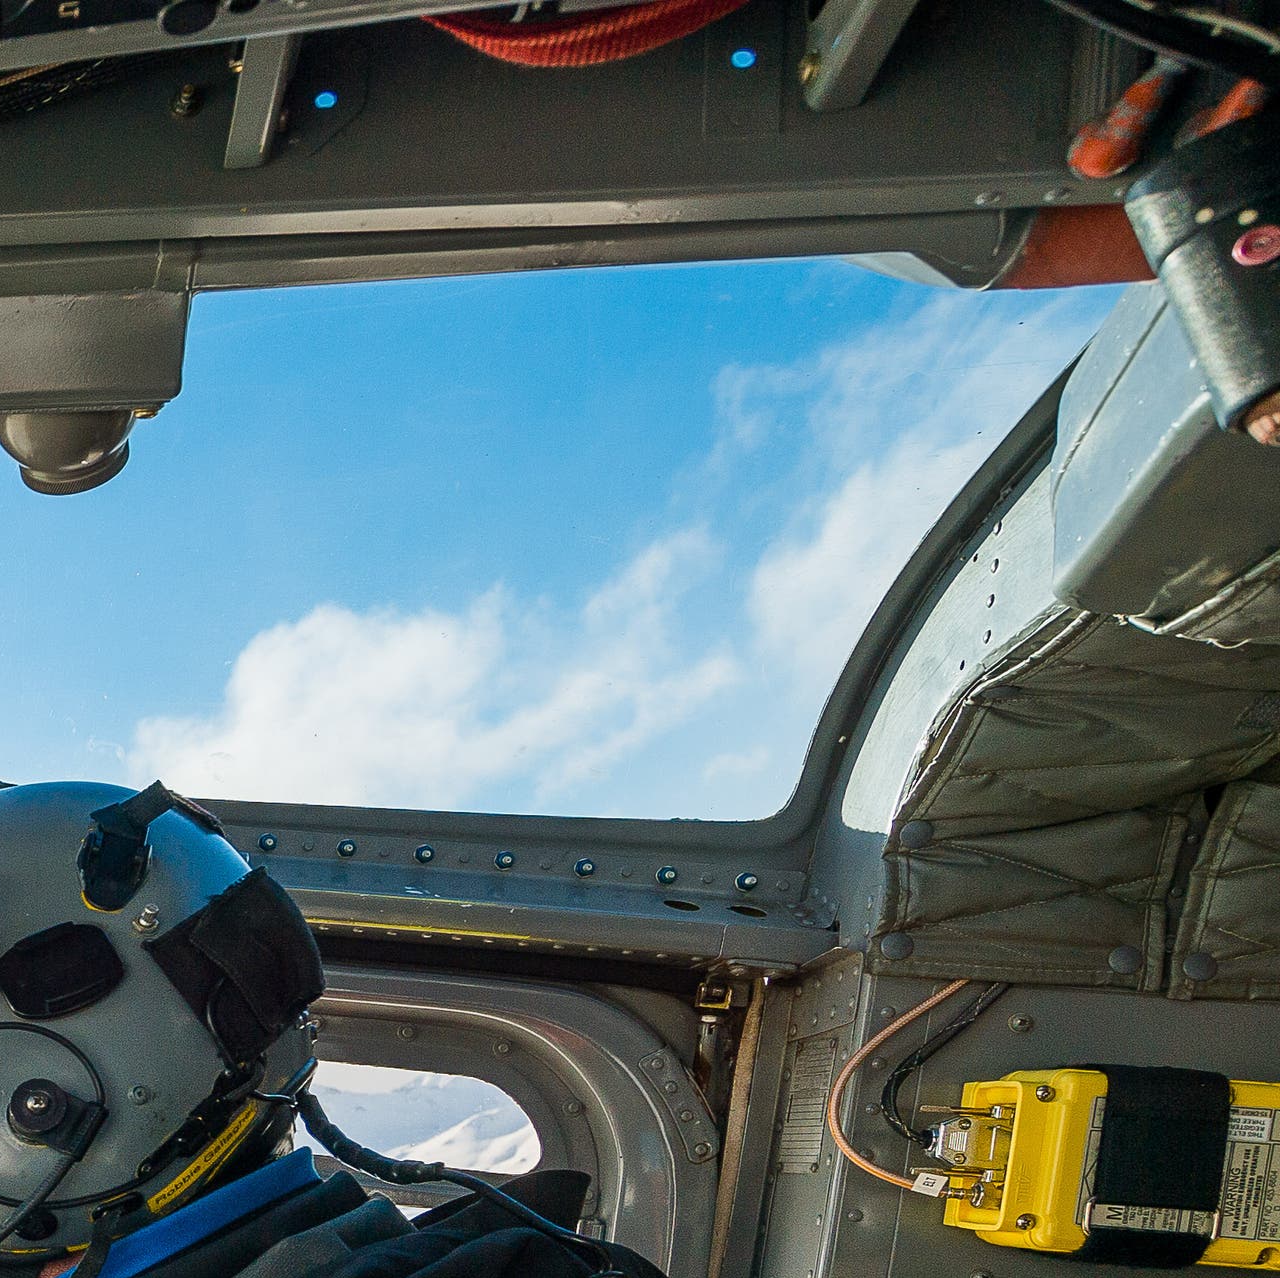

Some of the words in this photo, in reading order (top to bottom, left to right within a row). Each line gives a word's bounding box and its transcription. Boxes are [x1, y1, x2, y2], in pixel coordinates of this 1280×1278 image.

[155, 1165, 201, 1204] Robbie
[1224, 1167, 1241, 1217] WARNING
[1261, 1221, 1269, 1237] PART
[1265, 1205, 1272, 1219] NO
[1270, 1222, 1278, 1238] REV
